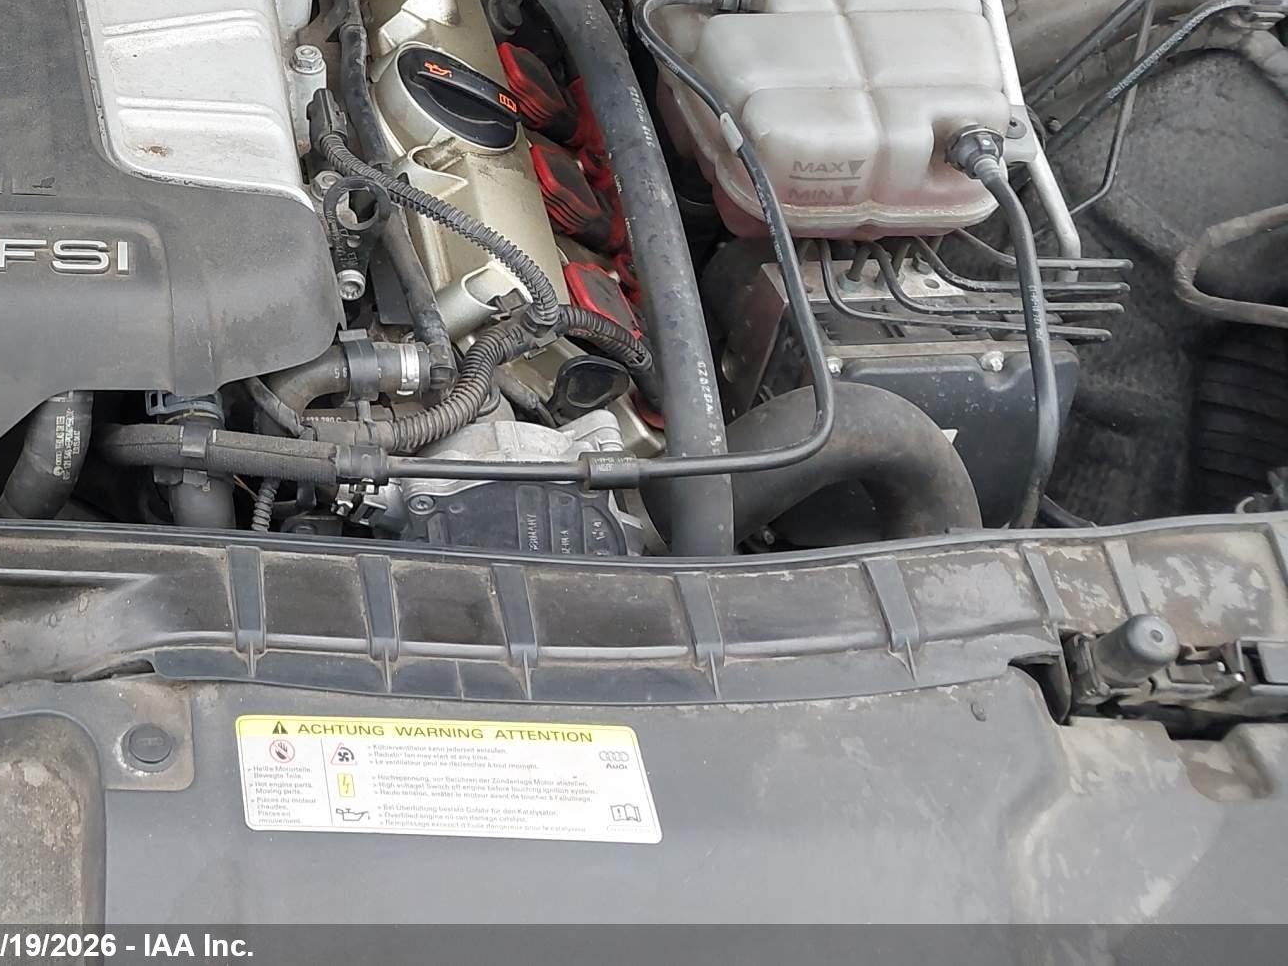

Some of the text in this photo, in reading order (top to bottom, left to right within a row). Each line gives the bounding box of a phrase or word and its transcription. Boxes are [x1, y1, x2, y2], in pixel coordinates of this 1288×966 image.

[792, 160, 844, 173] MAX
[297, 723, 593, 743] ACHTUNG WARNING ATTENTION
